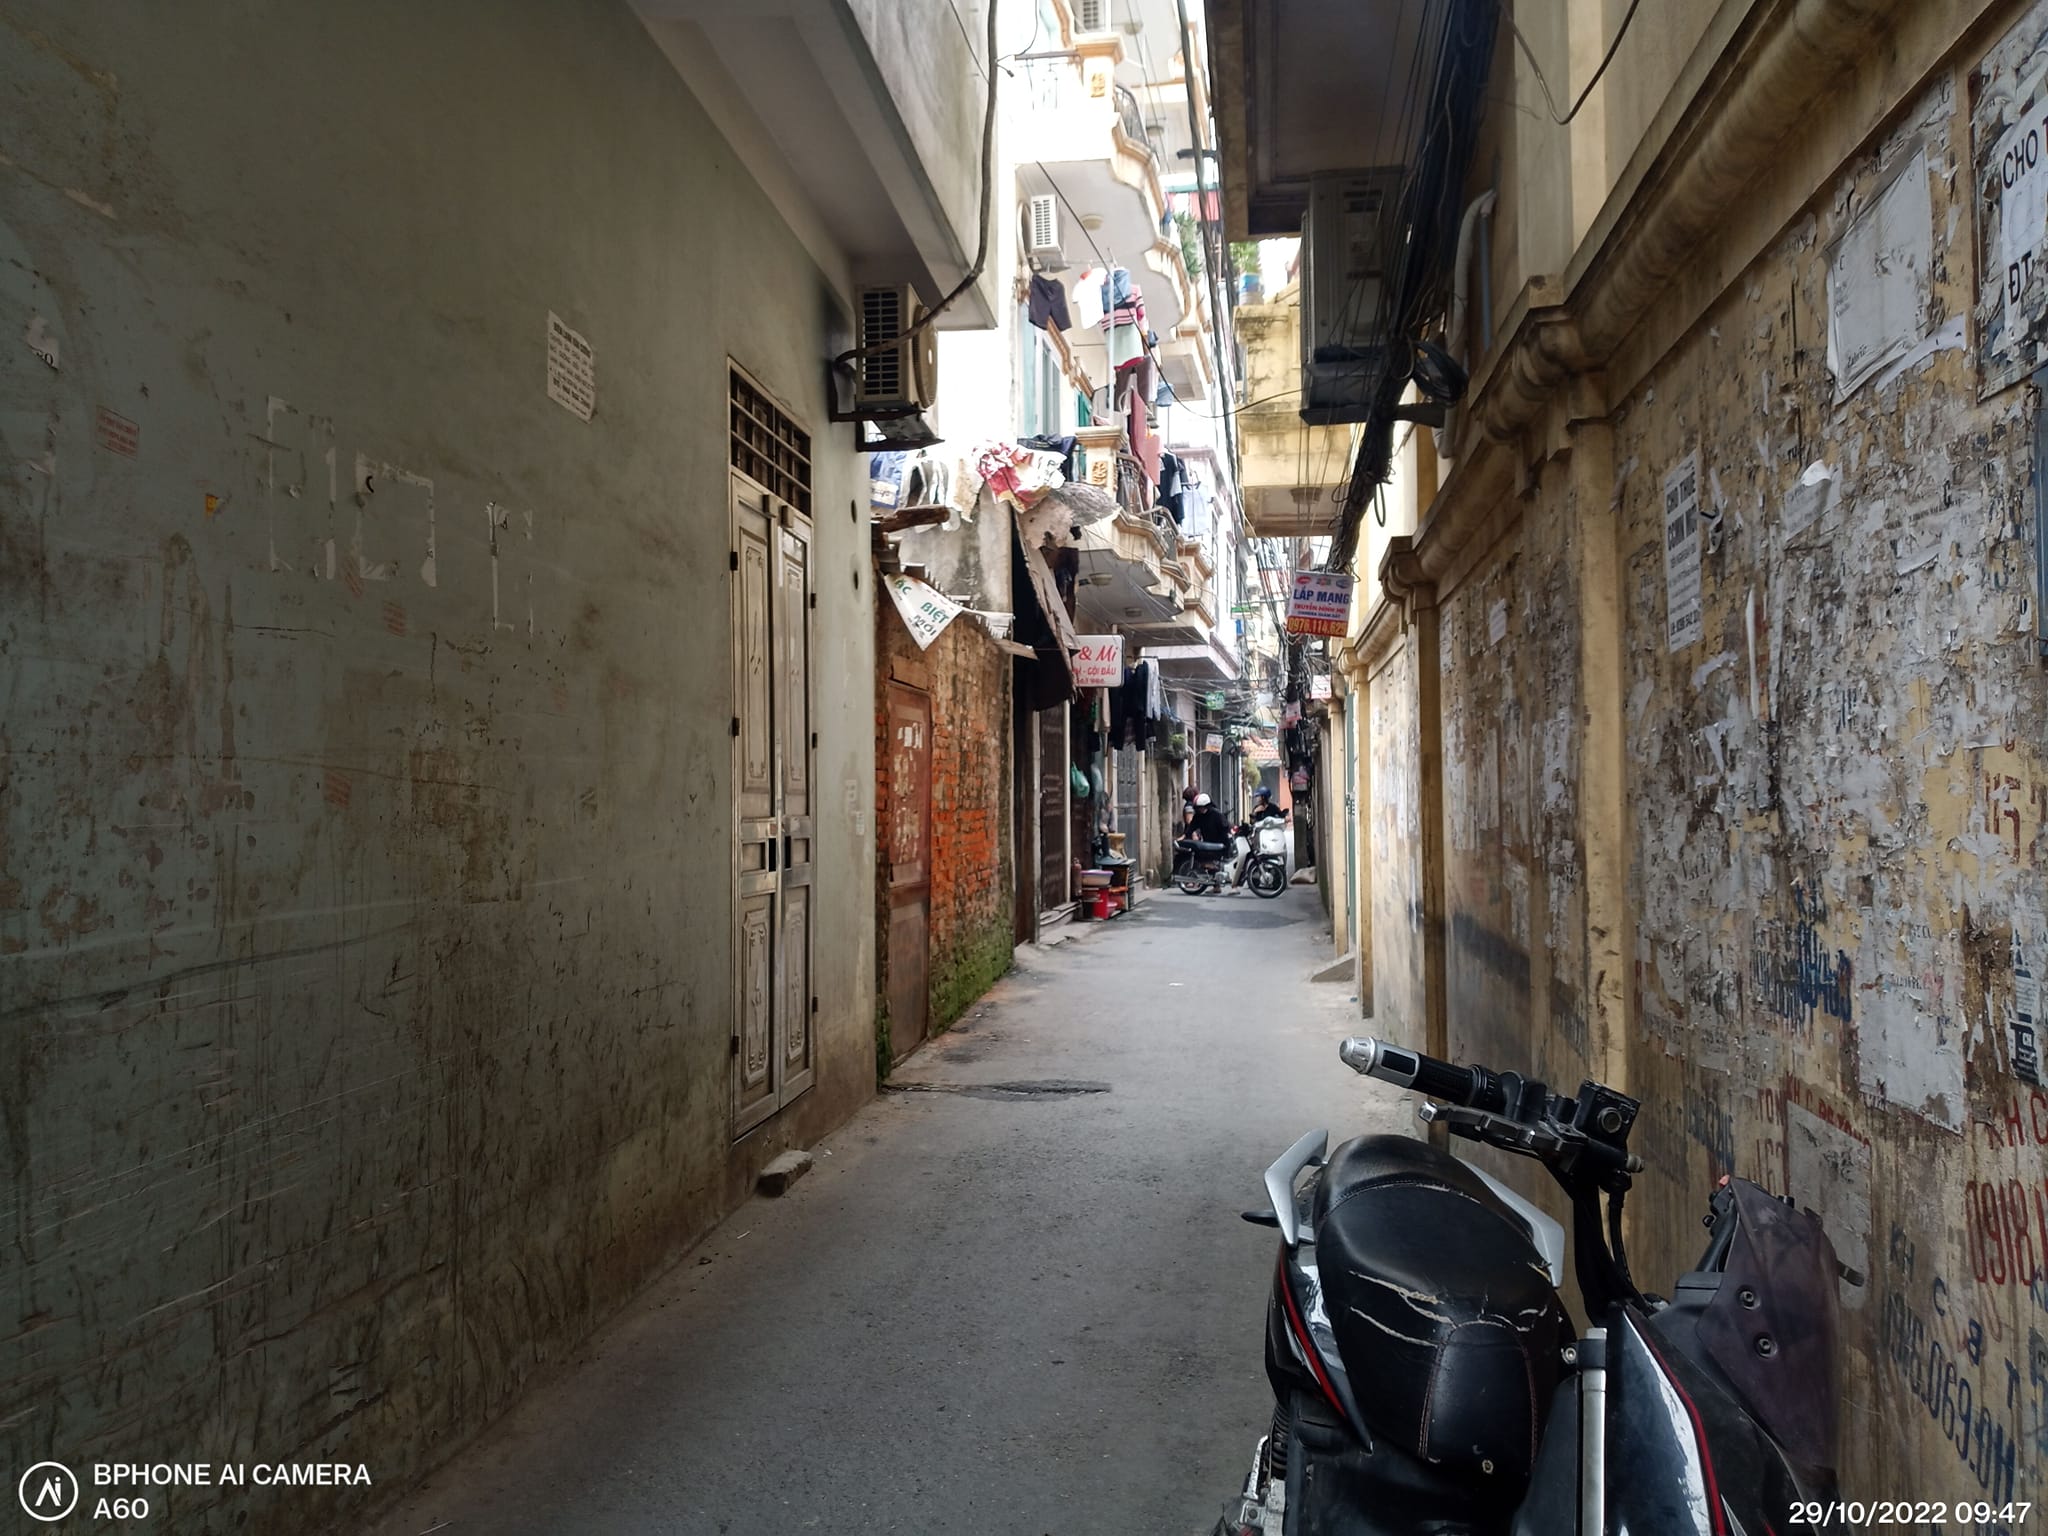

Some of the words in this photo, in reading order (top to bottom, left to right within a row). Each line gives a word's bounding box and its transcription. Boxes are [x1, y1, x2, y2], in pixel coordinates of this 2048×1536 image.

[2003, 129, 2038, 190] CHO
[1317, 591, 1351, 606] MẠNG
[921, 601, 951, 624] BIỆT
[1096, 644, 1119, 662] Mi
